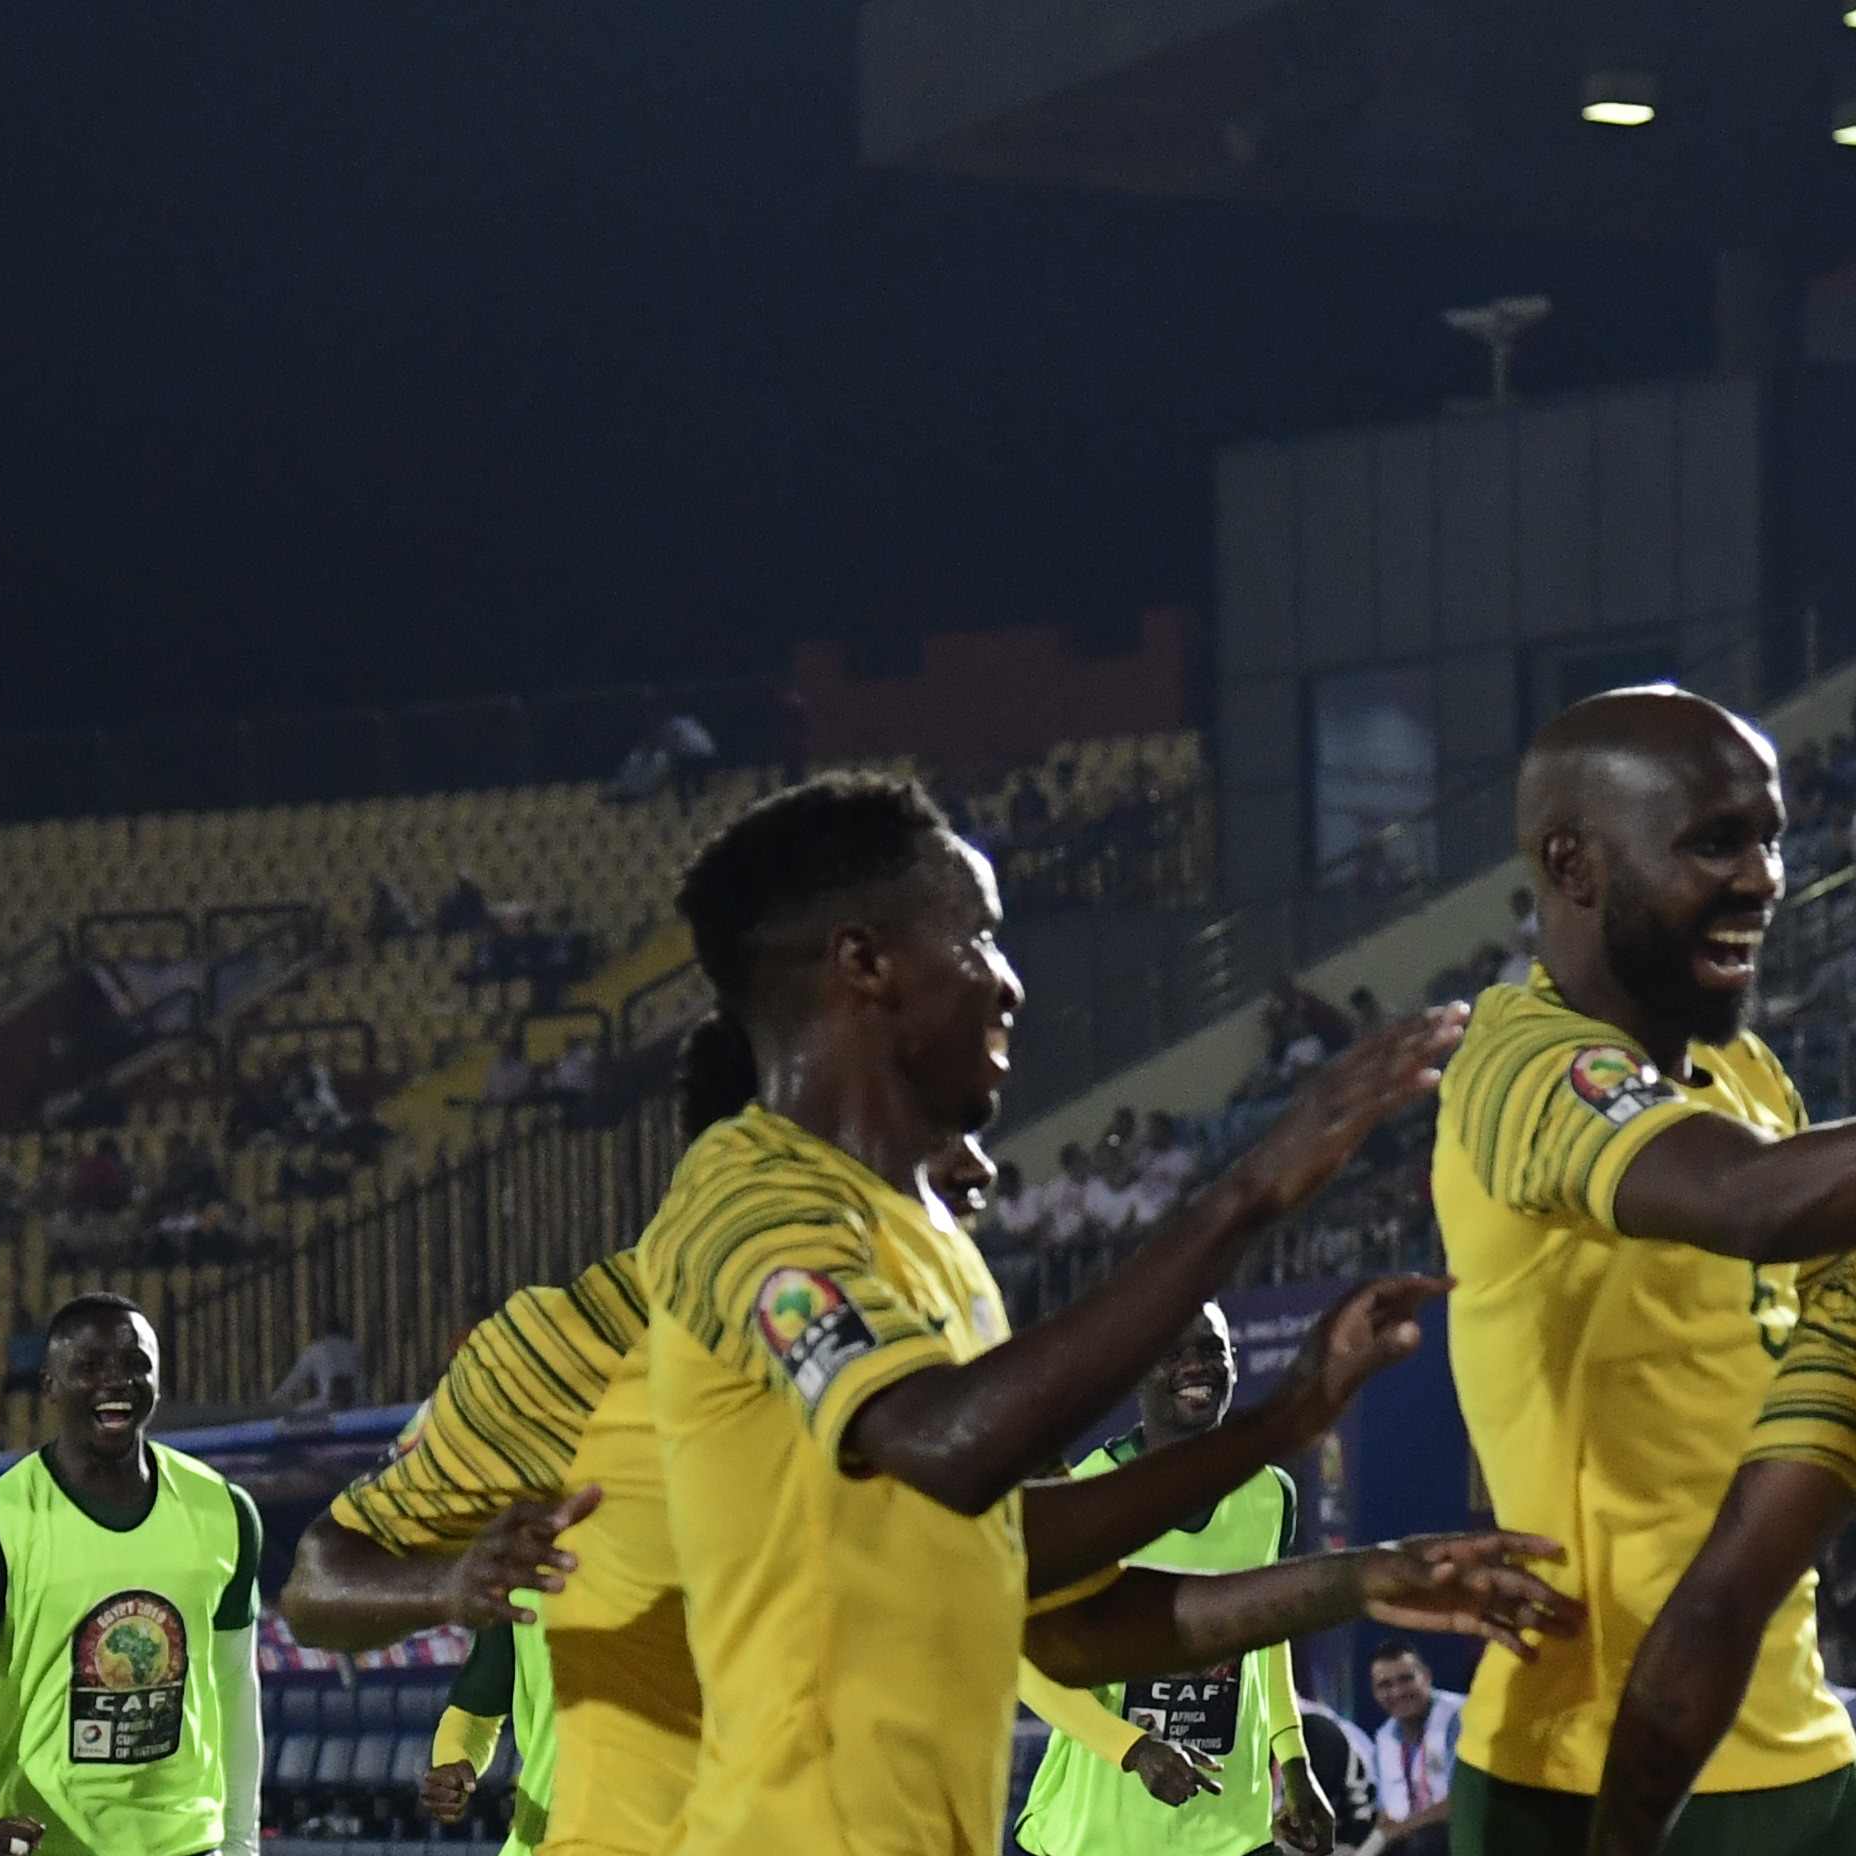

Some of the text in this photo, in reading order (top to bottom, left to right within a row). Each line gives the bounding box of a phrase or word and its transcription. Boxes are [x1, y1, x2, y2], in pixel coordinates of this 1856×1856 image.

[1150, 1681, 1221, 1702] CAF
[95, 1690, 168, 1713] CAF
[1169, 1710, 1207, 1724] AFRICA
[1168, 1724, 1192, 1738] CUP
